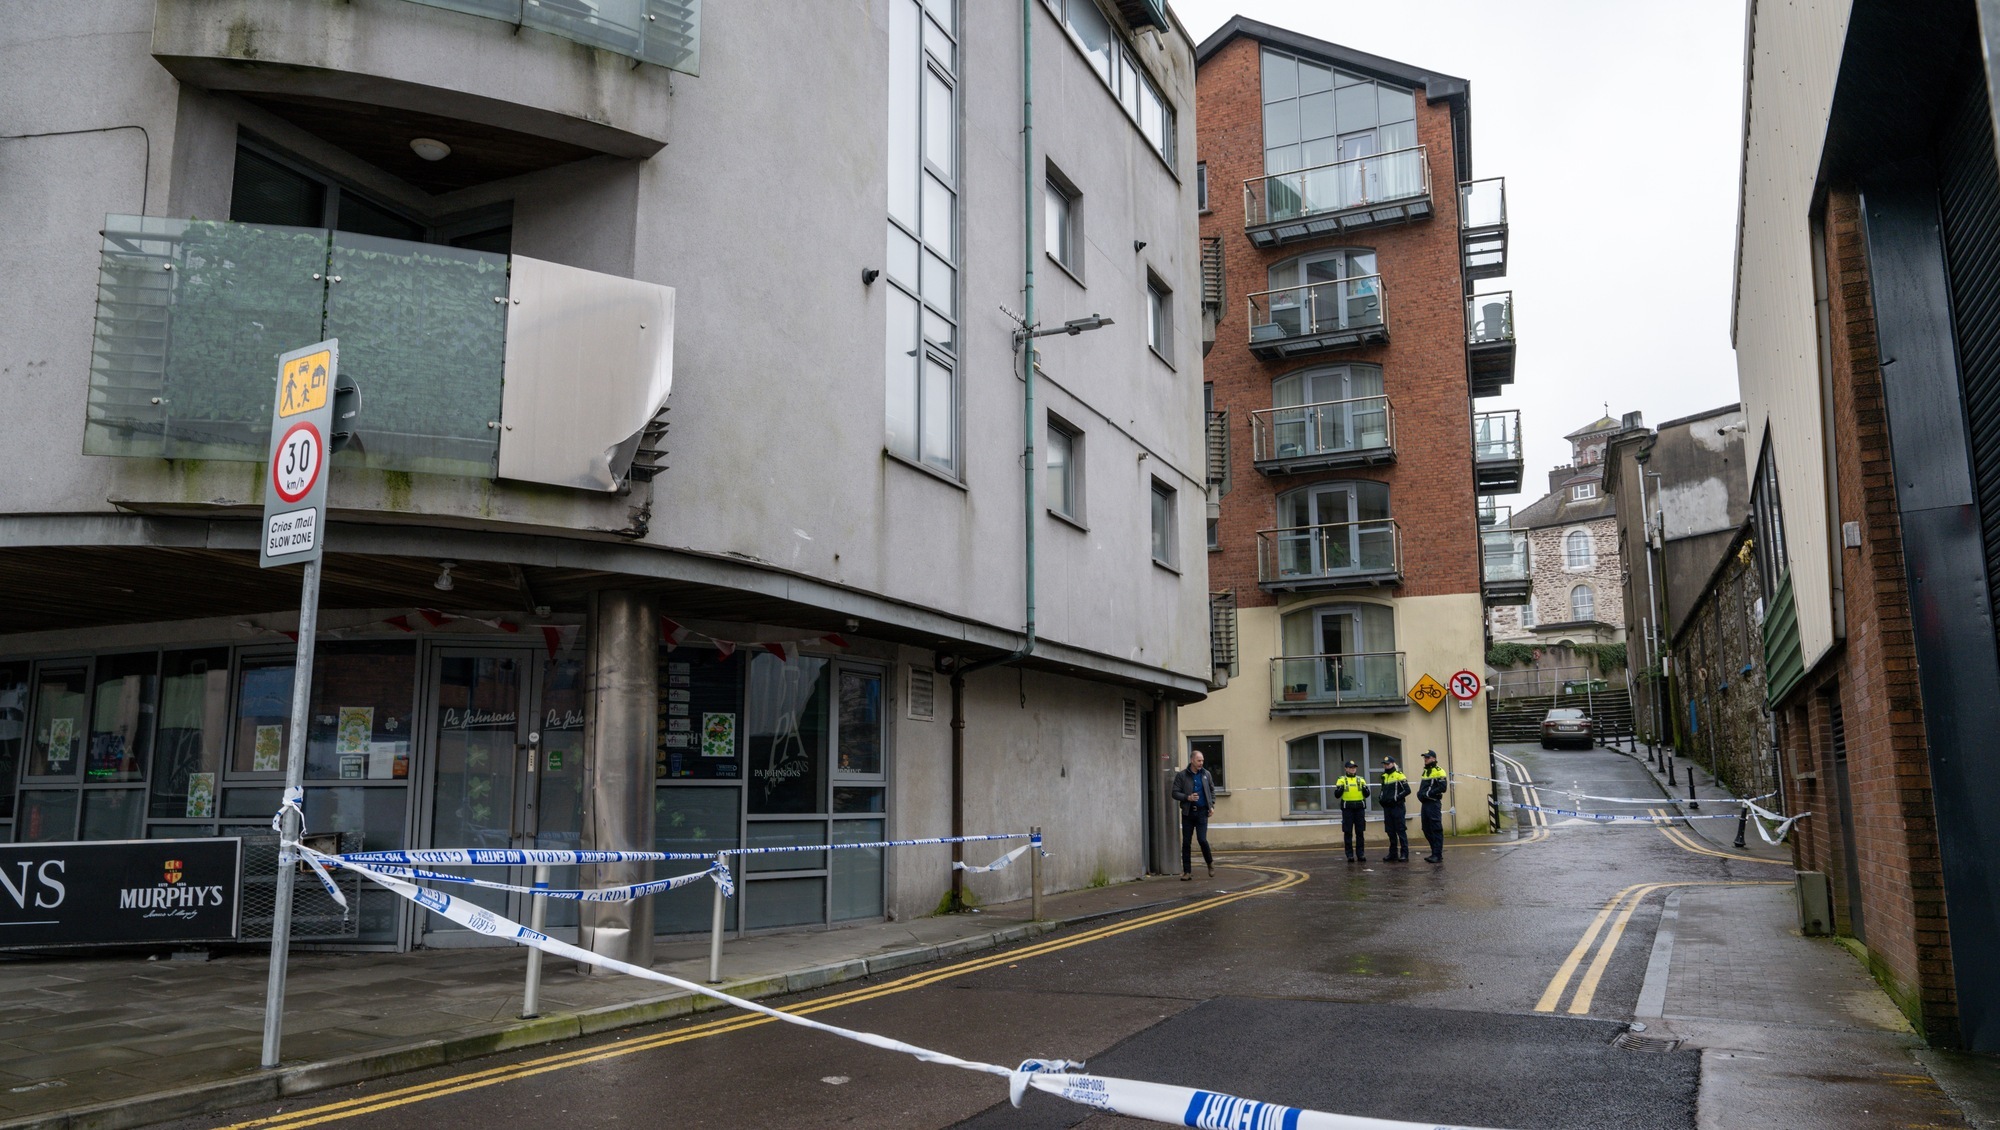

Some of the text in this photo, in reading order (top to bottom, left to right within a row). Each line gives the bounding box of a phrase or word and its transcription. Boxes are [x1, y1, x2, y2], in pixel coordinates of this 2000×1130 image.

[286, 440, 310, 475] 30
[286, 477, 304, 490] km/h
[271, 515, 313, 534] Crios Mall
[270, 532, 312, 549] SLOW ZONE
[444, 708, 516, 729] Pa Johnsons
[546, 708, 561, 727] Pa
[764, 769, 800, 779] JOHNSONS
[412, 851, 463, 862] GARDA
[476, 851, 503, 863] ENTRY
[507, 851, 520, 862] NO
[529, 851, 571, 862] GARDA
[581, 852, 604, 863] ENTRY
[120, 886, 223, 909] MURPHY'S
[588, 890, 626, 901] GARDA
[634, 885, 644, 898] NO
[646, 882, 667, 895] ENTRY
[468, 914, 496, 934] GARDA
[1196, 1094, 1260, 1130] ENTRY
